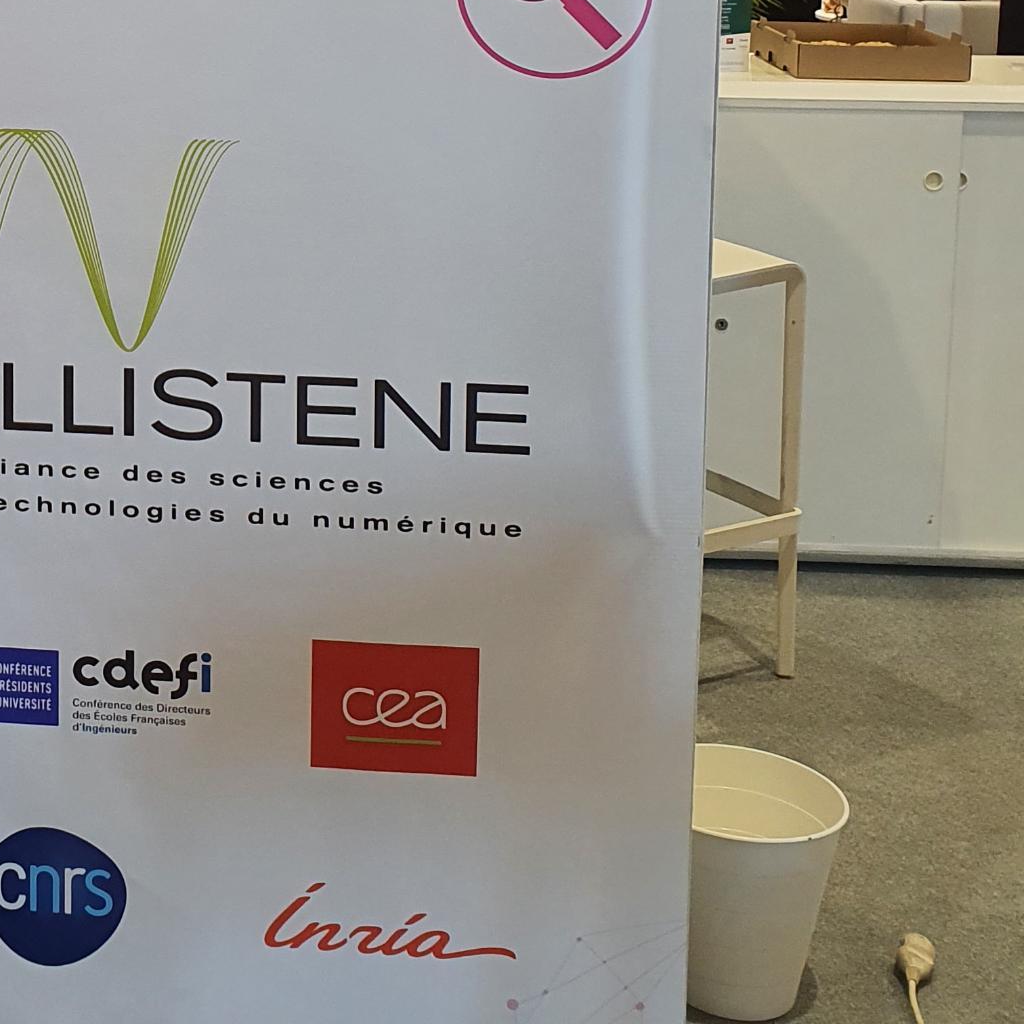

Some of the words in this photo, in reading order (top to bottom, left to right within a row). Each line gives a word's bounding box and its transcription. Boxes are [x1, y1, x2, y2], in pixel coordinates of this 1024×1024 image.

[122, 465, 186, 484] des
[209, 470, 383, 495] sciences
[248, 507, 289, 526] du
[313, 514, 522, 539] numérique
[73, 650, 212, 700] cdefi
[72, 697, 132, 711] Conférence
[134, 702, 154, 712] des
[156, 703, 211, 715] Directeurs
[72, 710, 91, 720] des
[93, 709, 128, 722] Écoles
[130, 713, 186, 726] Françaises
[342, 687, 447, 729] cea
[72, 723, 138, 735] d'Ingénieurs
